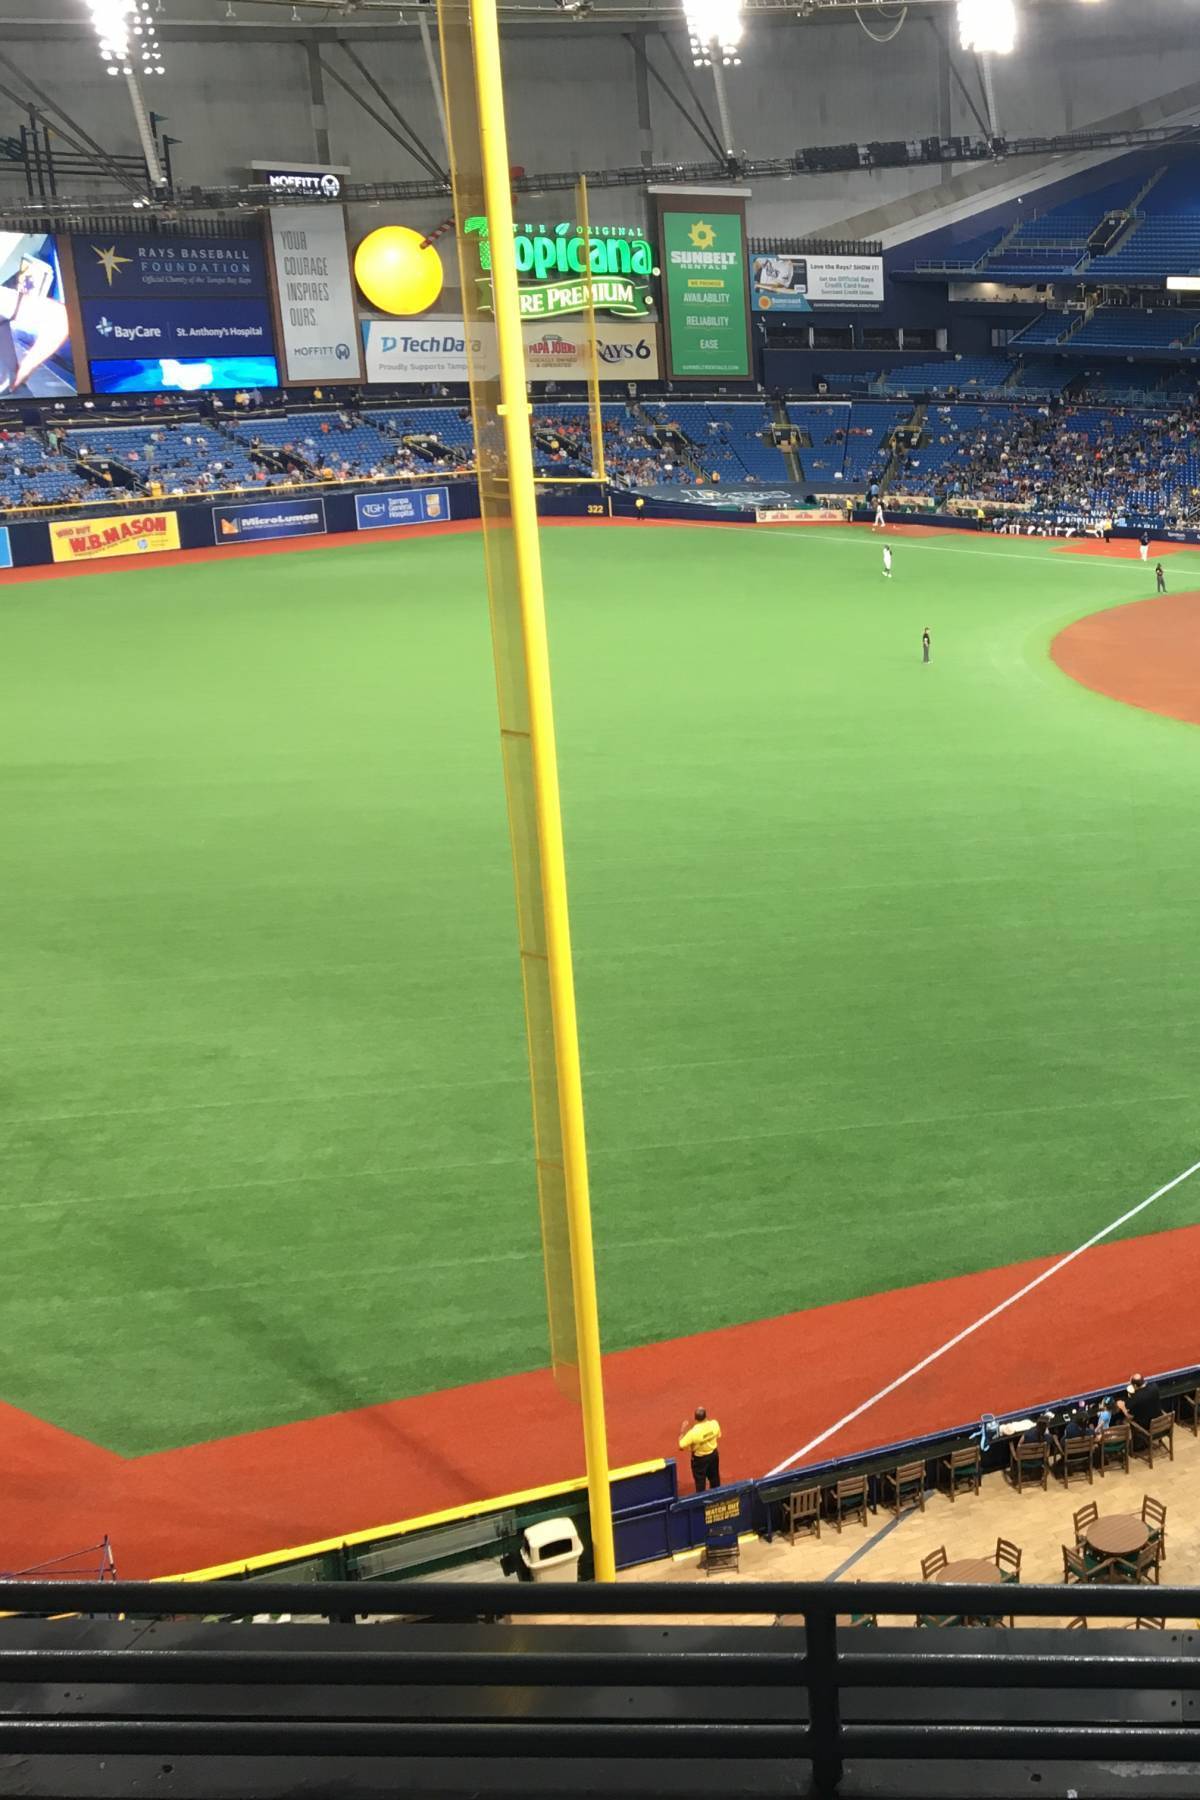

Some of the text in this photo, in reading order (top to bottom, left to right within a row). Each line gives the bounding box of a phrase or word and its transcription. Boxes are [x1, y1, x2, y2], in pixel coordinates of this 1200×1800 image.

[269, 175, 319, 188] MOFFITT
[280, 231, 308, 250] YOUR
[138, 247, 249, 260] RAYS BASEBALL
[671, 251, 736, 265] SUNBELT
[141, 262, 250, 273] FOUNDATION
[283, 257, 328, 276] COURAGE
[286, 283, 329, 301] INSPIRES
[546, 282, 634, 311] PREMIUM
[683, 293, 730, 303] AVAILABILITY
[289, 308, 318, 327] OURS.
[686, 316, 729, 326] RELIABILITY
[114, 326, 161, 341] BayCare
[176, 327, 262, 338] St. Anthony's Hospital
[529, 341, 550, 354] PAPA
[635, 339, 651, 359] 6
[700, 339, 719, 349] EASE
[294, 346, 333, 356] MOFFITT
[379, 362, 408, 371] Proudly
[410, 363, 445, 371] Supports
[367, 504, 385, 513] TGH
[587, 505, 604, 514] 322
[241, 513, 319, 527] MicroLumen
